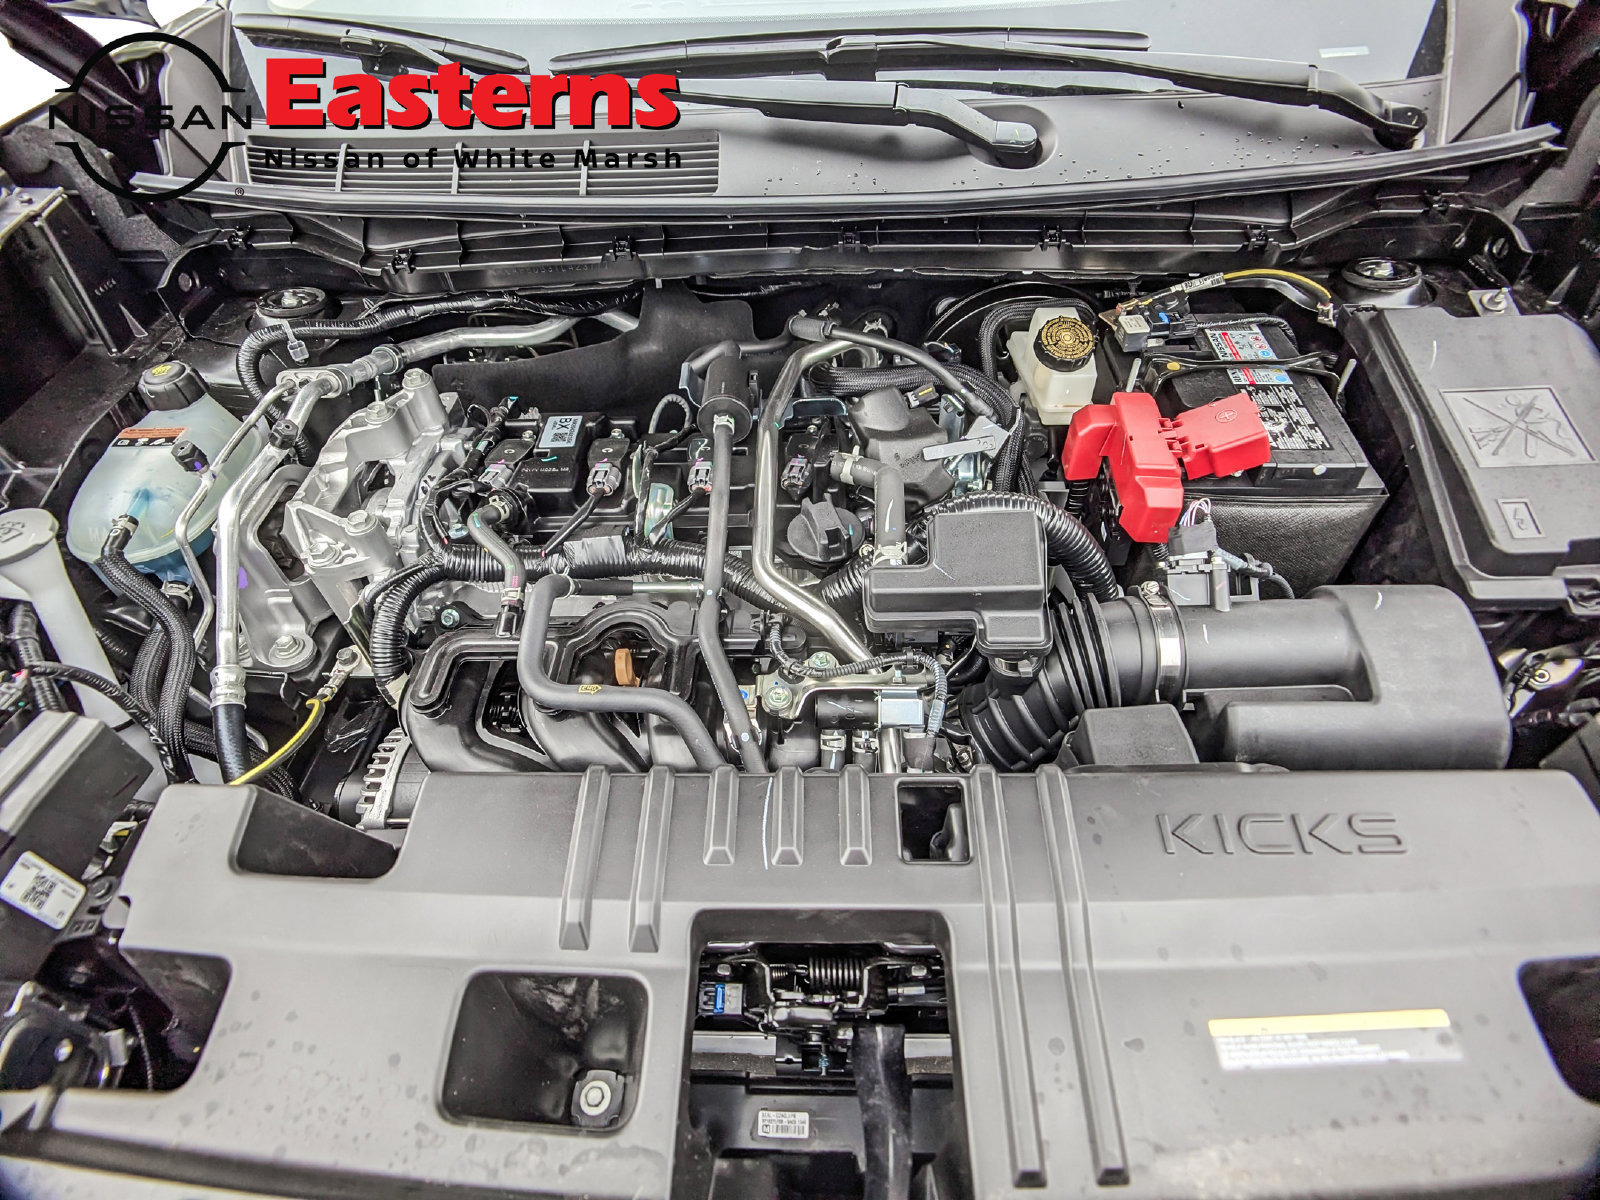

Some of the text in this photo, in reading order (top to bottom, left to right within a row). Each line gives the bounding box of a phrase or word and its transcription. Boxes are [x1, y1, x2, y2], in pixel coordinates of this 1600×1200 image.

[1209, 332, 1229, 358] NISSAN
[557, 417, 572, 430] BX
[1156, 812, 1408, 855] KICKS
